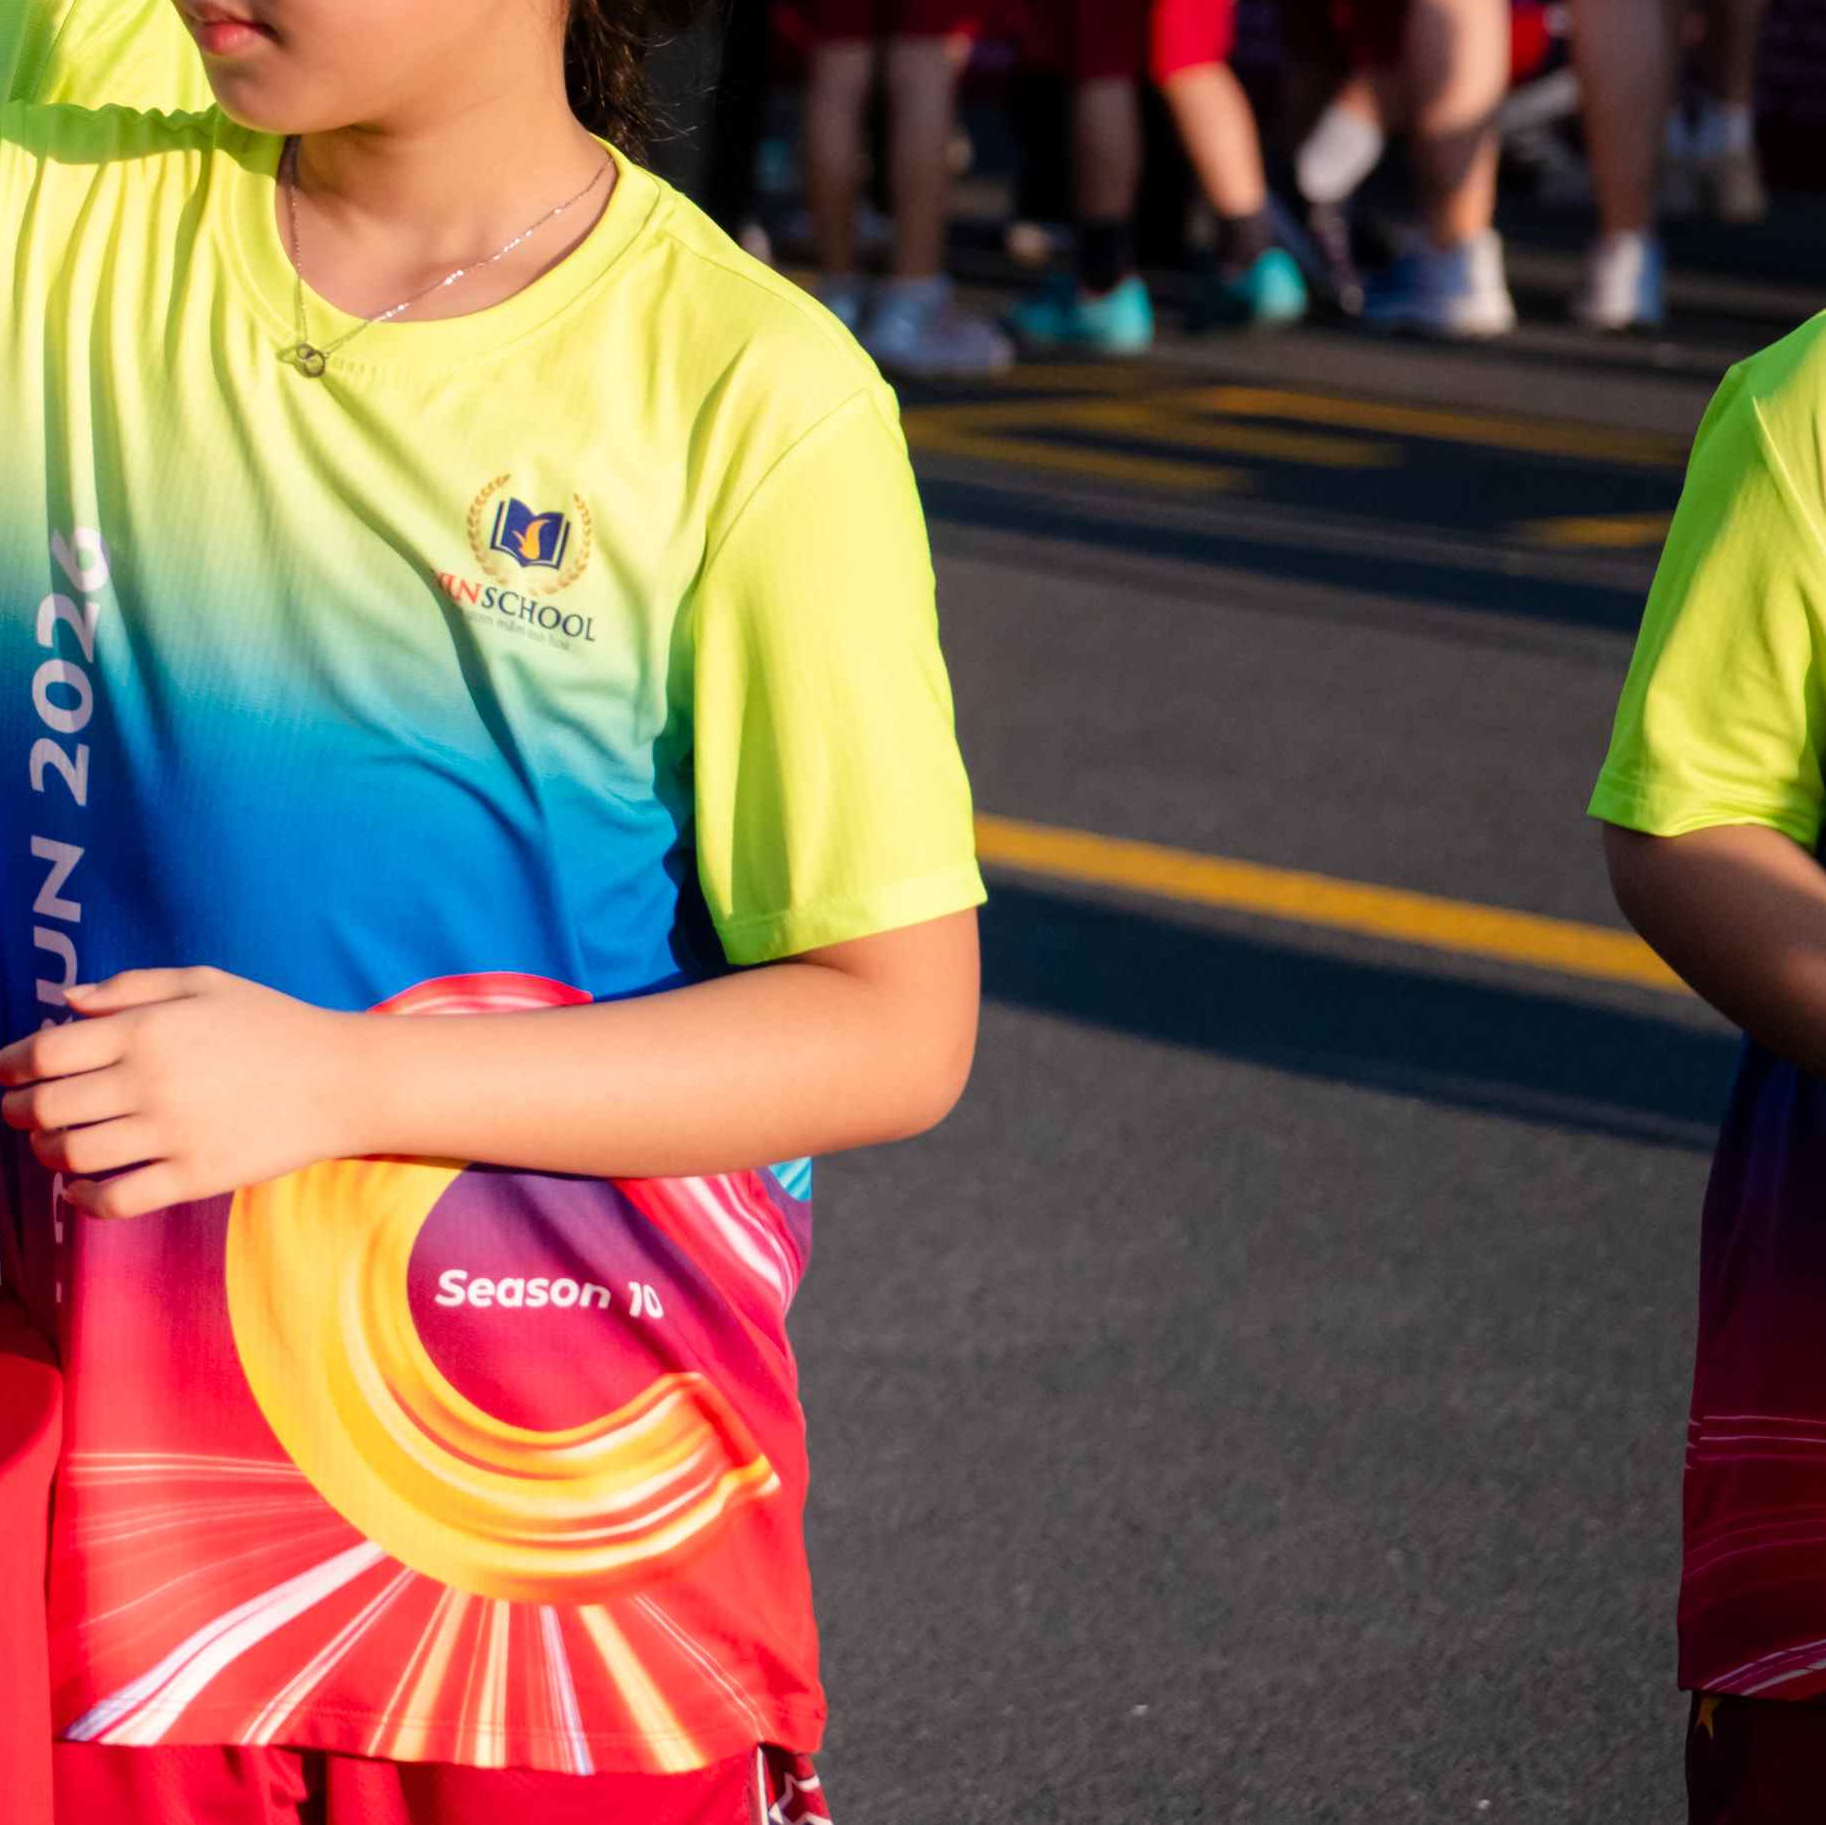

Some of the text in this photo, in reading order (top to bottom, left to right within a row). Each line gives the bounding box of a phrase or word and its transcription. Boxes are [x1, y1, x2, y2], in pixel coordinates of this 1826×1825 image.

[29, 526, 111, 808] 2026
[434, 1268, 665, 1319] Season 10
